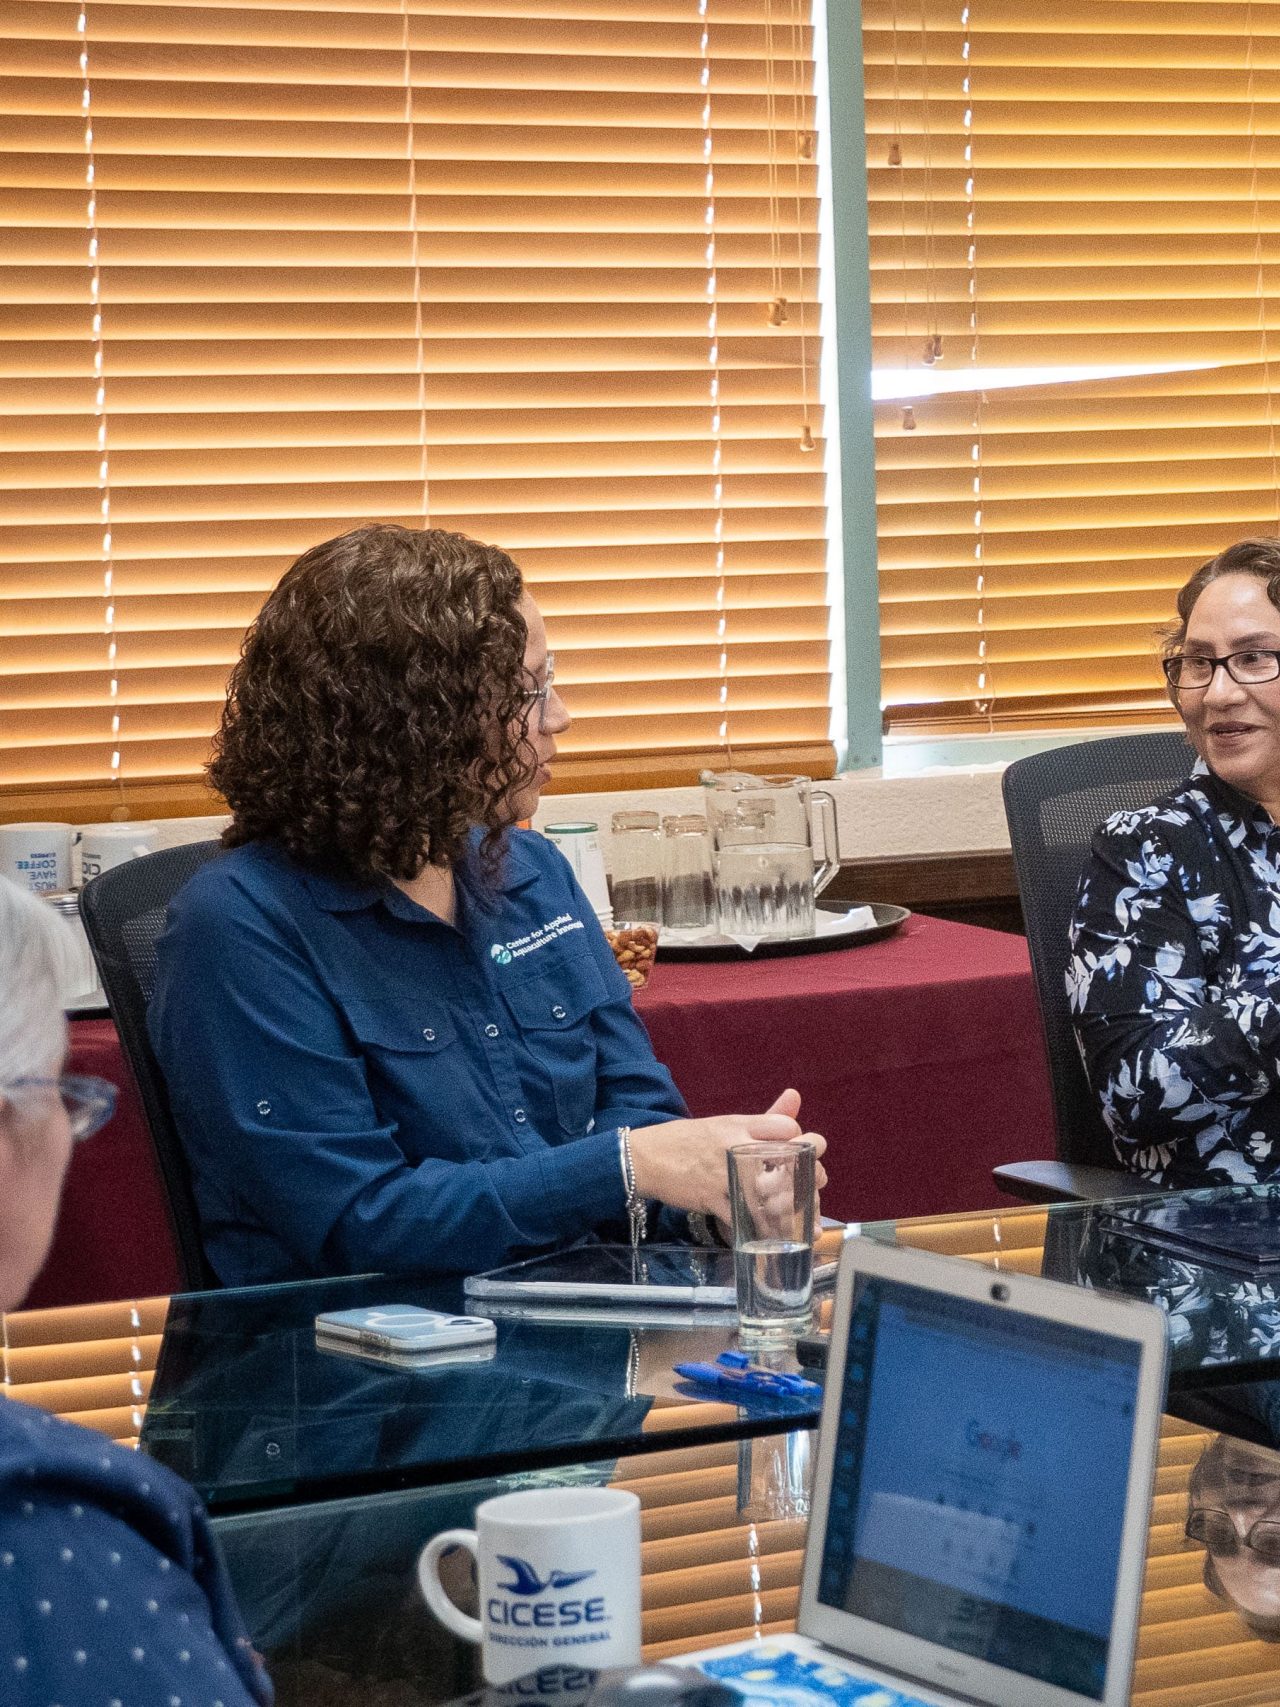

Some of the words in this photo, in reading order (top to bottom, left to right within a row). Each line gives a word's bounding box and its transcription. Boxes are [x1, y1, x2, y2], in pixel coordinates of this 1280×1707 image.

[28, 871, 57, 880] HAVE
[81, 861, 101, 876] CIC
[506, 935, 531, 950] Center
[531, 929, 544, 939] for
[512, 931, 558, 958] Aquaculture
[488, 1596, 605, 1627] CICESE
